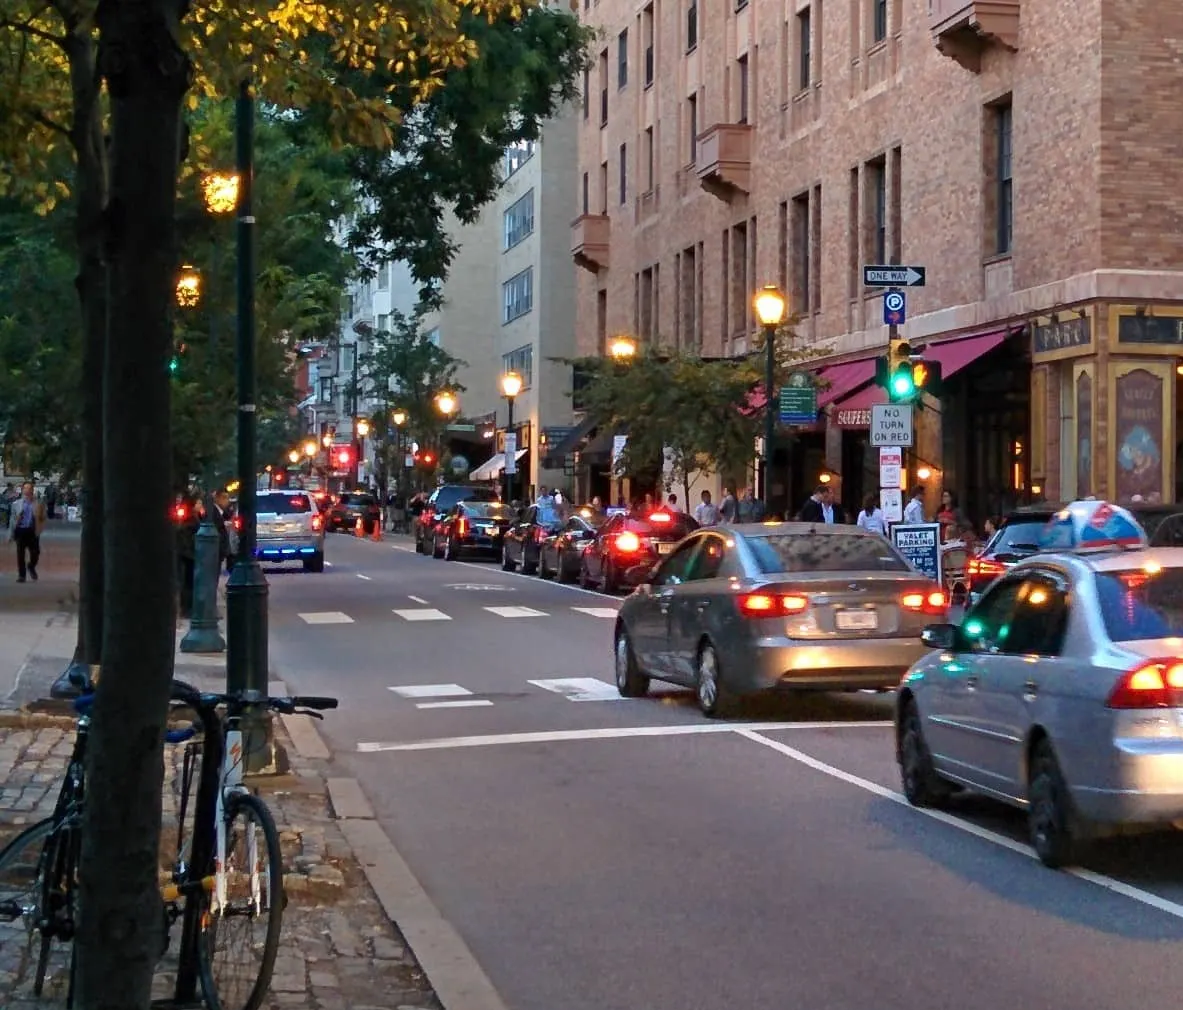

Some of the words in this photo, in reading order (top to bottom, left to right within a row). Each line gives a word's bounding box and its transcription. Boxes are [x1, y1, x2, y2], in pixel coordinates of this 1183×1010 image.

[870, 271, 889, 281] ONE
[890, 272, 907, 281] WAY
[884, 408, 900, 418] NO
[880, 420, 904, 430] TURN
[874, 432, 888, 442] ON
[890, 432, 909, 441] RED
[898, 538, 934, 547] PARKING
